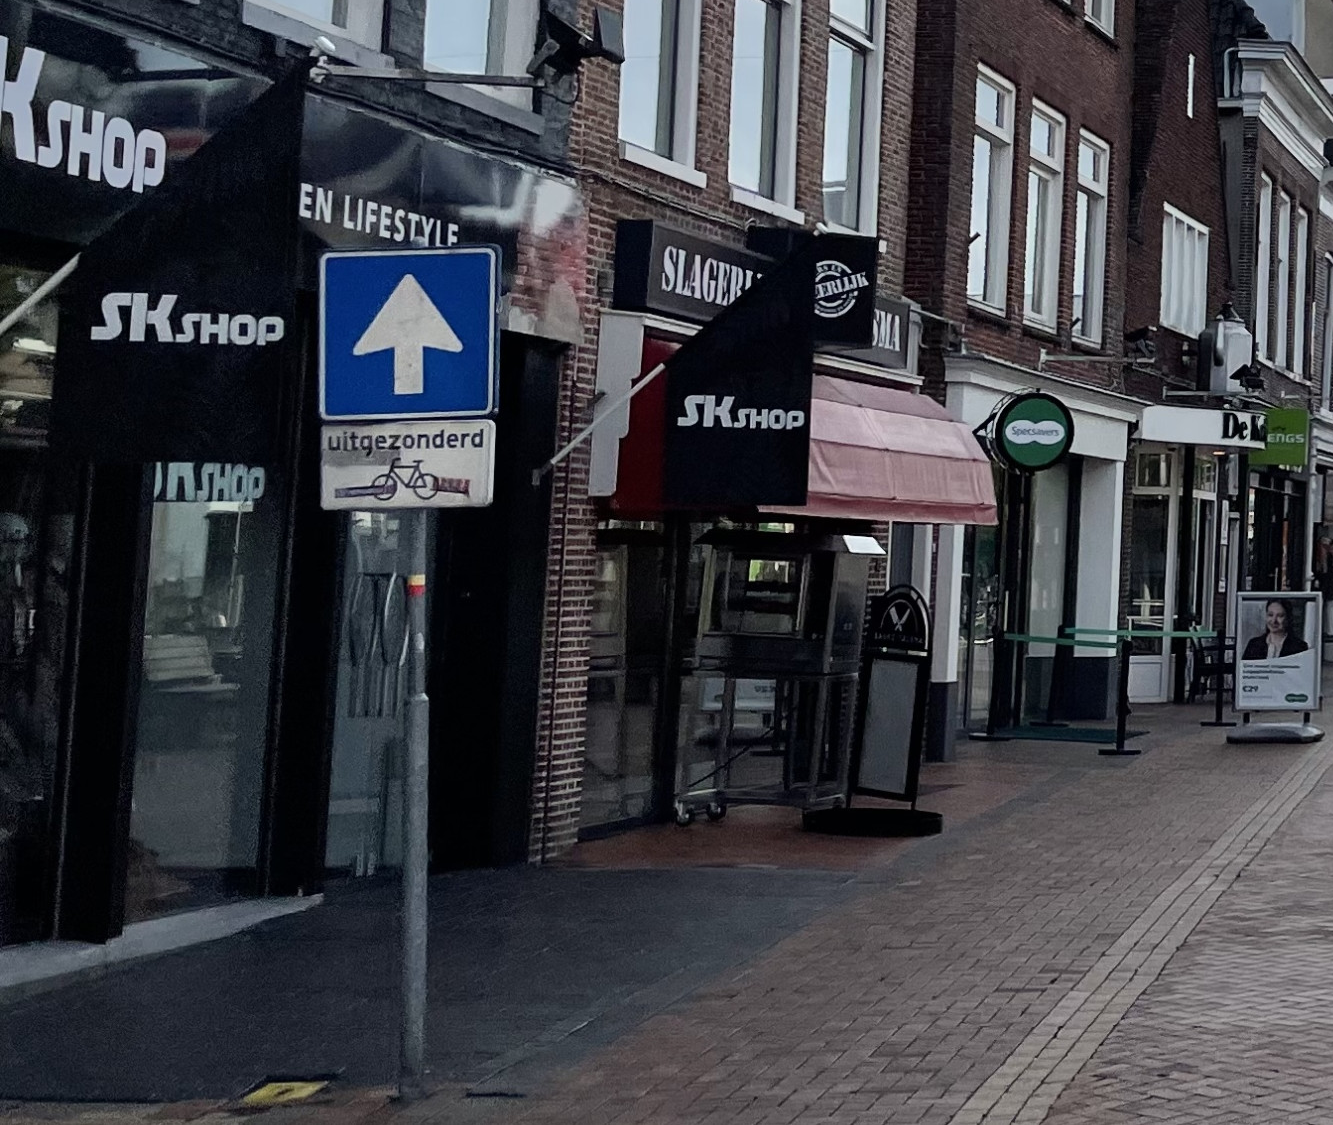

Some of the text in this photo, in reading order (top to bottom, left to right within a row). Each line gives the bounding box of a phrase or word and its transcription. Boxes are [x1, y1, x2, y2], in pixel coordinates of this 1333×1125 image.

[299, 182, 459, 248] EN LIFESTYLE
[1011, 426, 1060, 437] Specsavers
[1222, 412, 1249, 441] De
[327, 428, 485, 457] uitgezonderd
